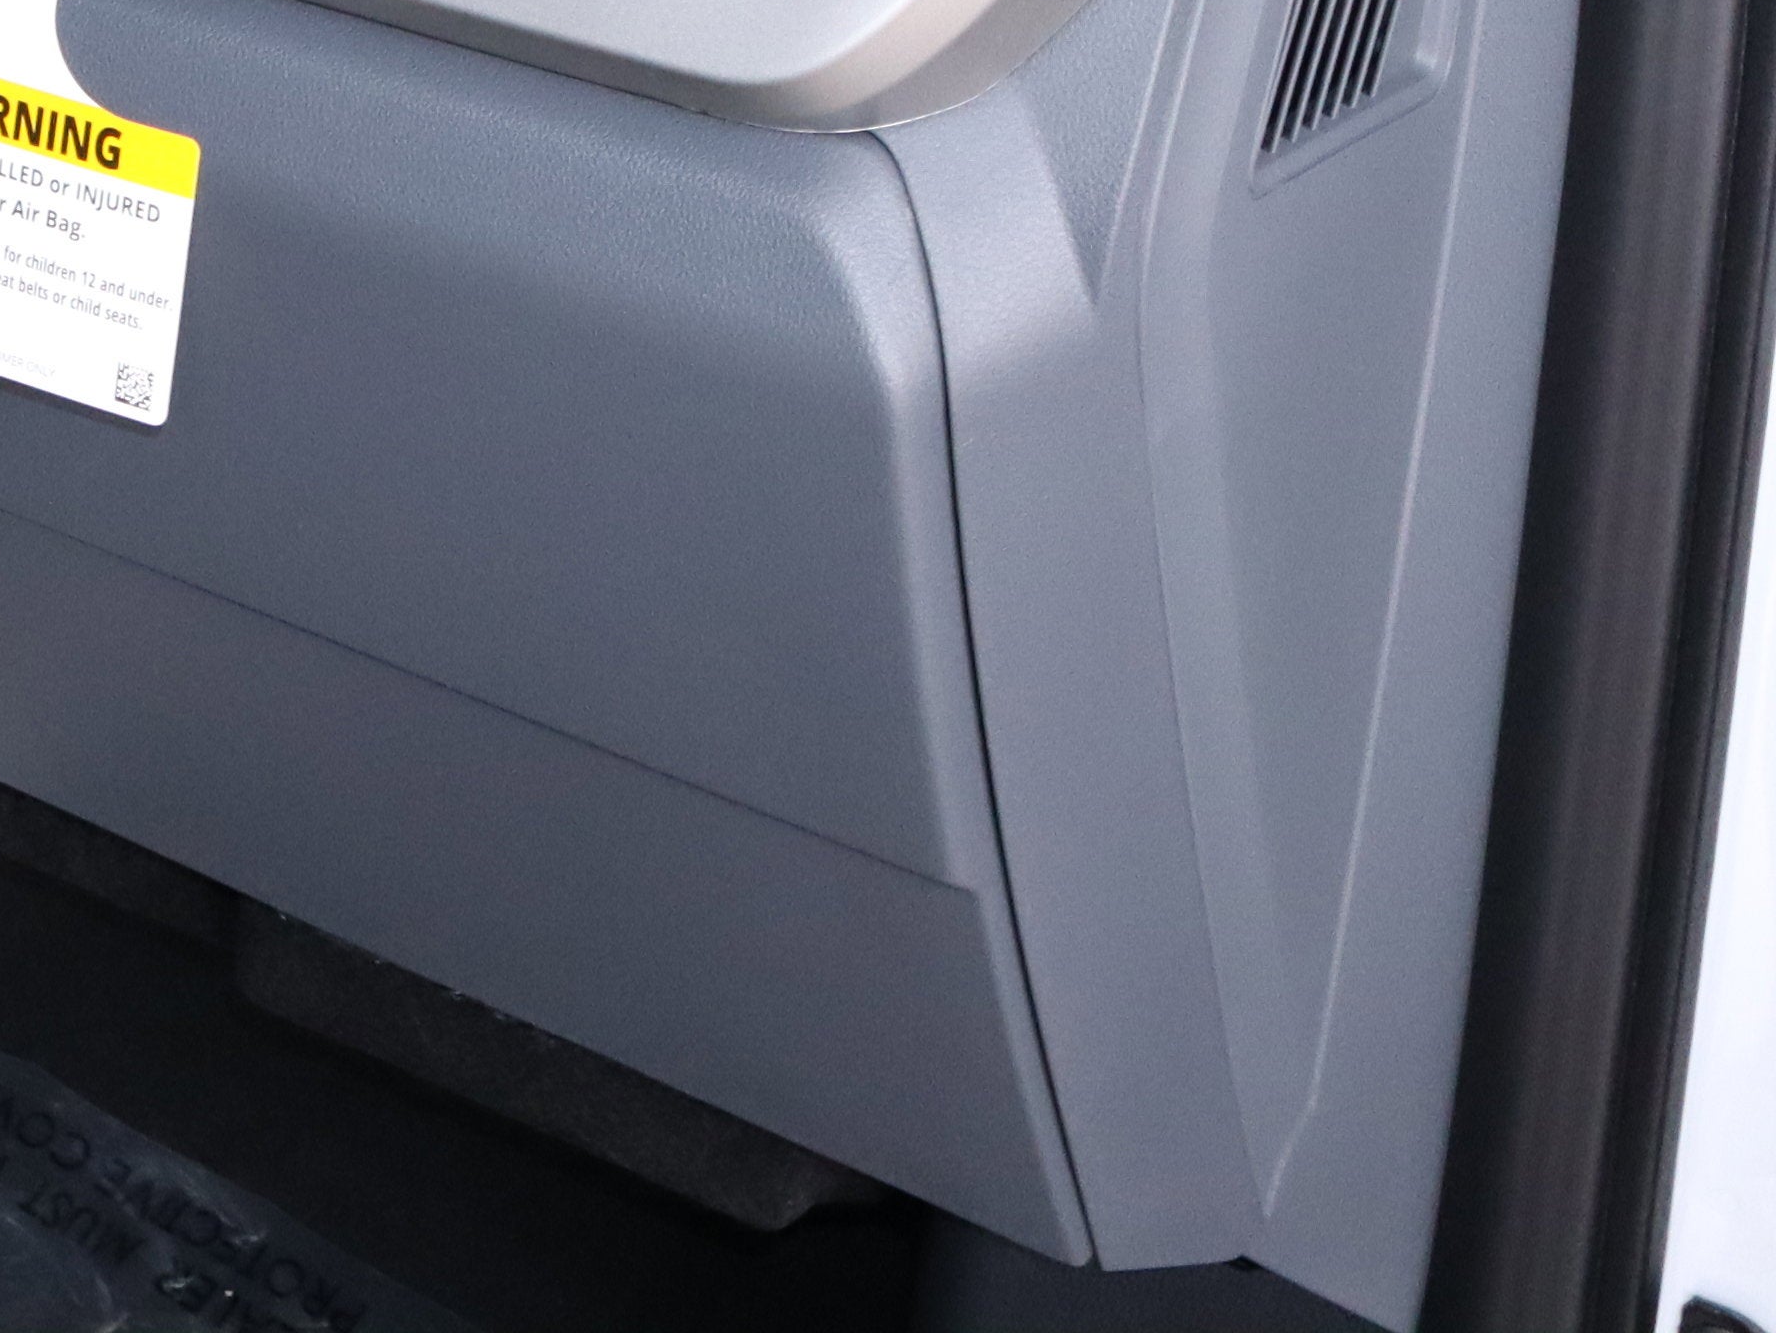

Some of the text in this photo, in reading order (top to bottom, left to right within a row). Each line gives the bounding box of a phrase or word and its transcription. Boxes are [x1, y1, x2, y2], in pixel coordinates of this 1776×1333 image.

[10, 200, 40, 222] Air
[45, 210, 86, 241] Bag.
[49, 179, 69, 195] or
[75, 183, 160, 222] INJURED
[3, 246, 22, 264] for
[24, 255, 76, 282] children
[81, 271, 96, 288] 12
[99, 279, 125, 297] and
[128, 288, 173, 311] under.
[17, 277, 48, 300] belts
[52, 292, 66, 305] or
[69, 296, 100, 317] child
[104, 308, 143, 330] seats.
[25, 358, 56, 378] ONLY
